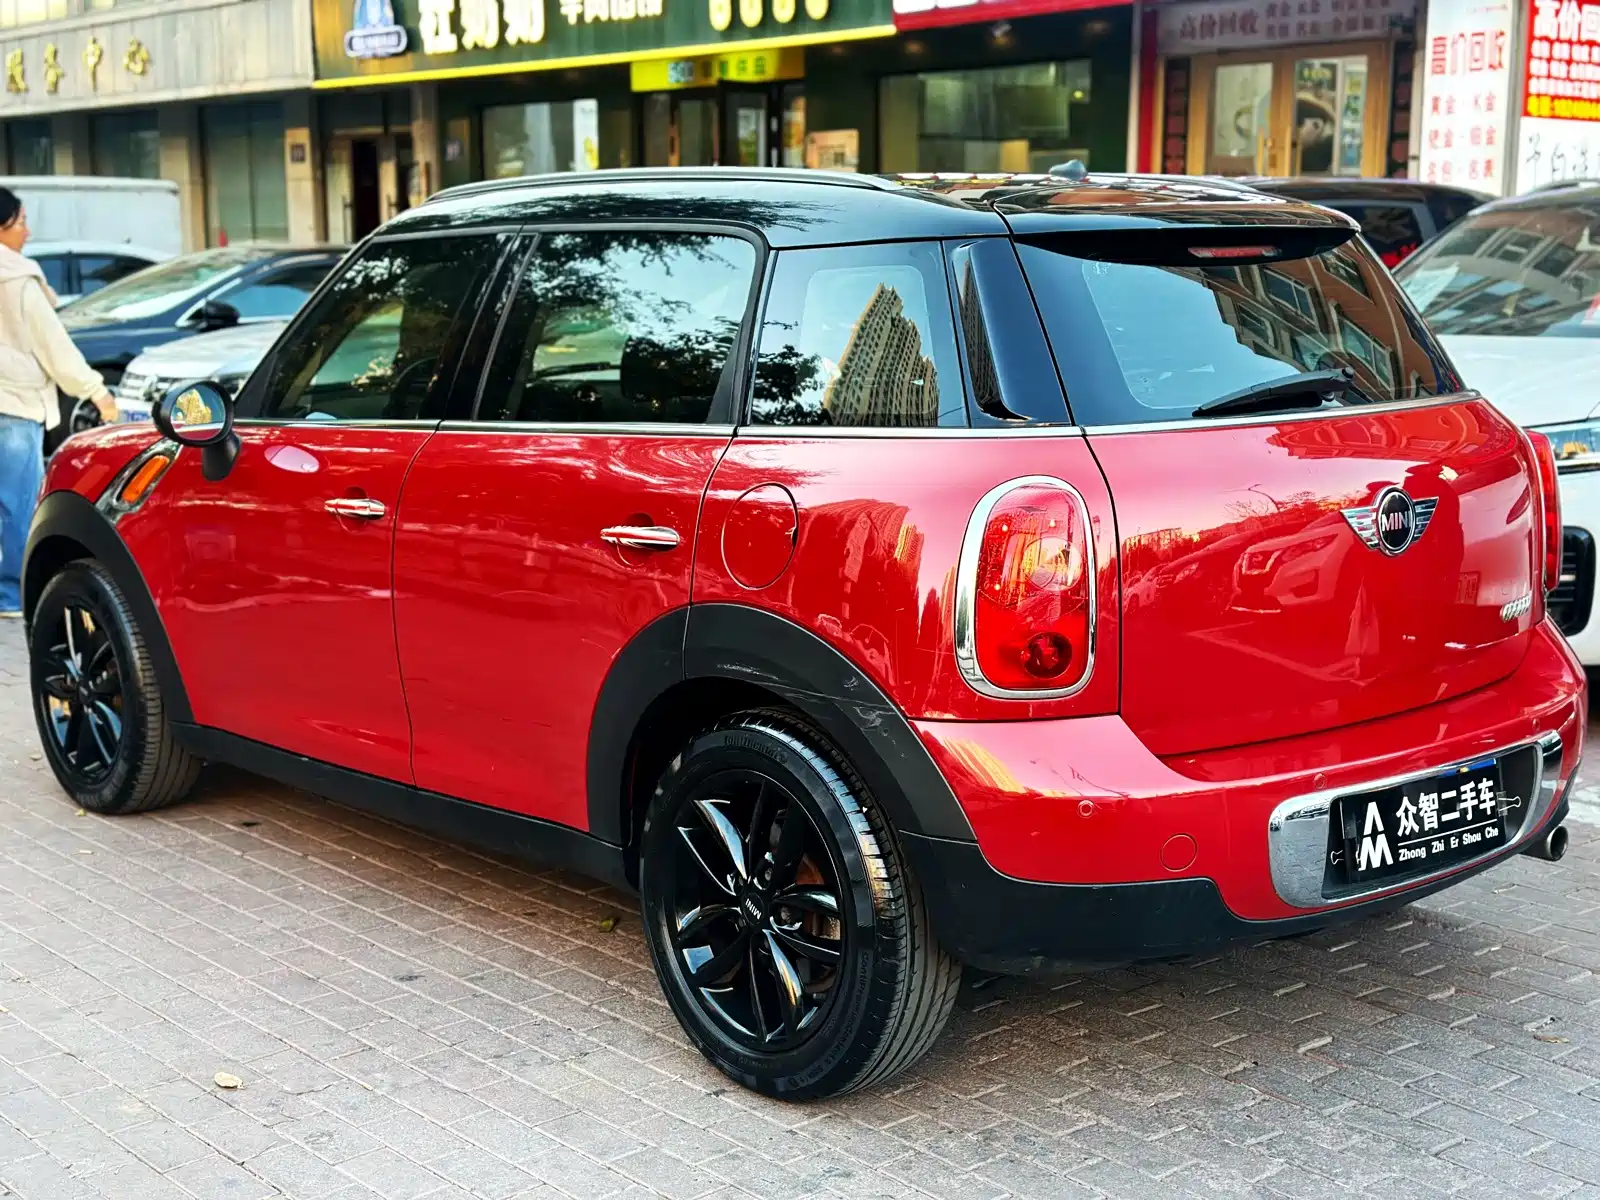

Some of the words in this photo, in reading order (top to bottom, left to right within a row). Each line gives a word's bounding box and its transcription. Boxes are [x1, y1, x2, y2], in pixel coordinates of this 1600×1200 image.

[1431, 31, 1505, 76] 高价回收
[1381, 511, 1413, 531] MINI
[1396, 777, 1496, 836] 众智二手车
[1399, 845, 1426, 861] Zhong
[1431, 840, 1445, 854] Zhi
[1450, 836, 1459, 849] Er
[1463, 833, 1481, 845] Shou
[1485, 827, 1498, 838] Che
[745, 898, 762, 921] MINI
